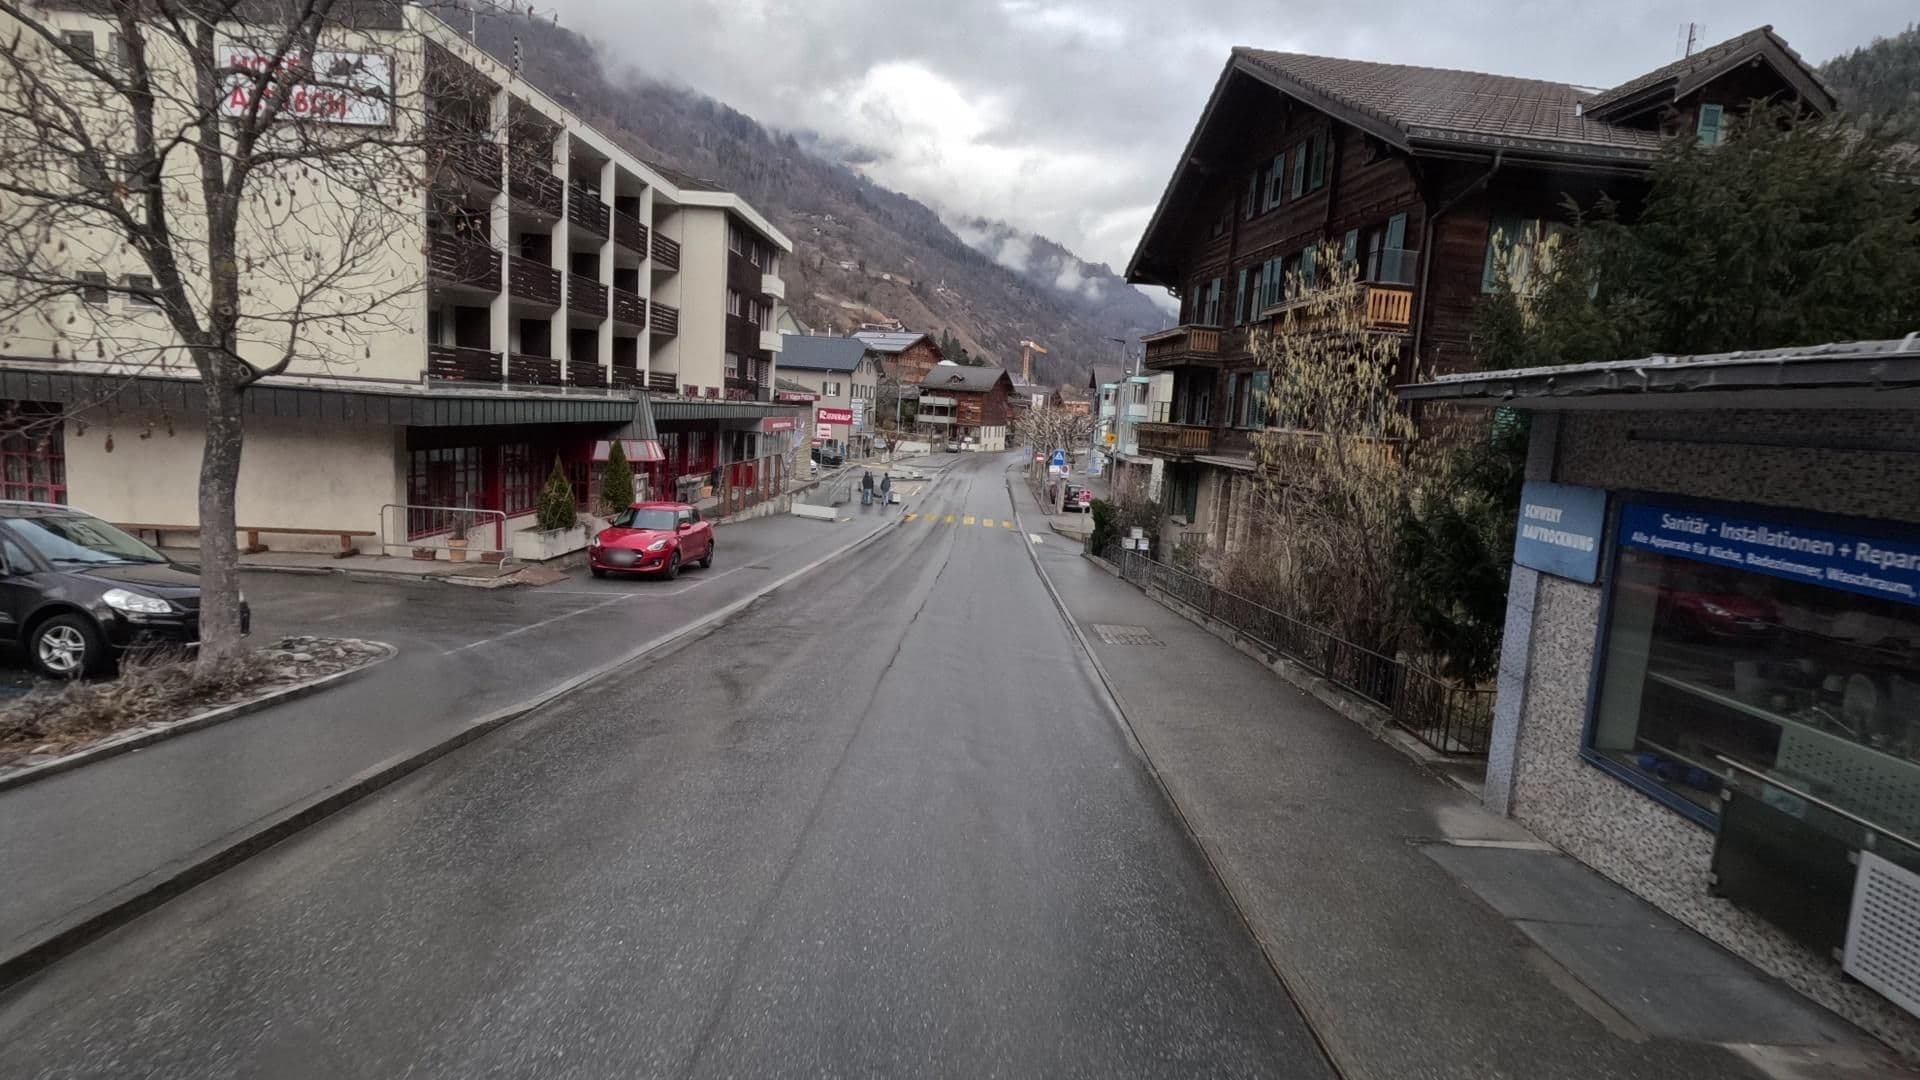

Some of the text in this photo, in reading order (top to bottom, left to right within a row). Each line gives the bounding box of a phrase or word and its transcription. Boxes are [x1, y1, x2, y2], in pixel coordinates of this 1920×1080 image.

[1631, 531, 1649, 543] Alle
[1649, 535, 1692, 553] Apparate
[1692, 542, 1708, 556] für
[1708, 546, 1745, 563] Küche,
[1661, 513, 1710, 535] Sanitär
[1720, 522, 1834, 556] Installationen
[1855, 542, 1920, 571] Repar
